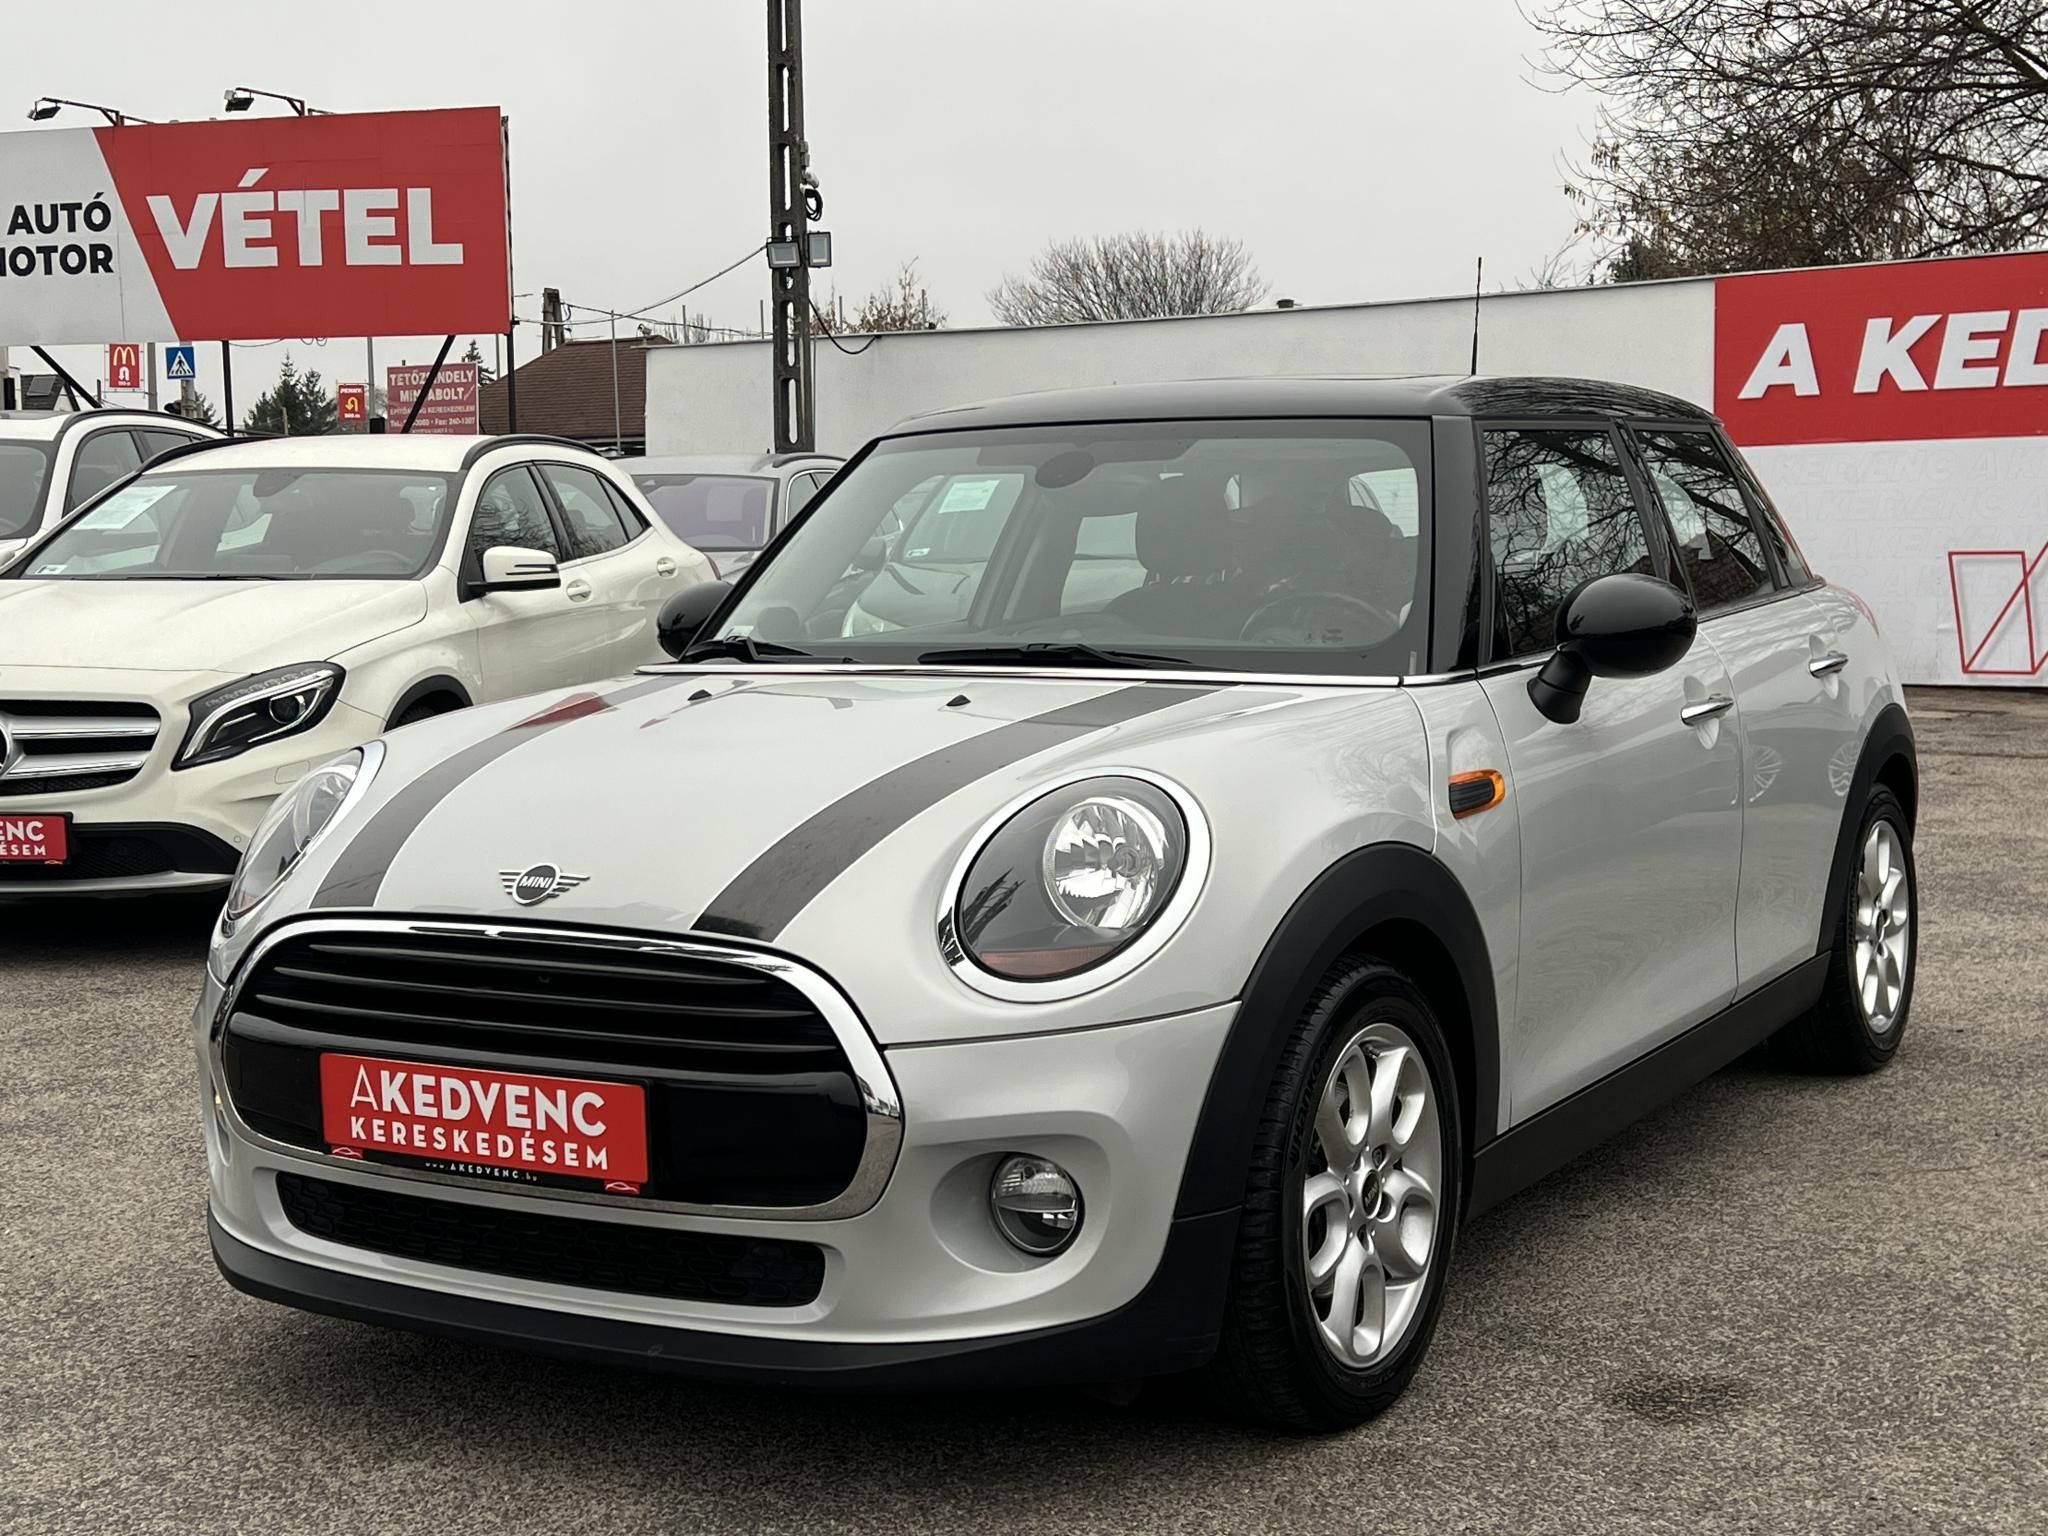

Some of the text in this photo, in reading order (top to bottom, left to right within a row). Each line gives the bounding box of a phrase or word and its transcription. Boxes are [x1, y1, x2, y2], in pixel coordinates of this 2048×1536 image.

[7, 191, 112, 236] AUTÓ
[146, 167, 465, 270] VÉTEL
[0, 243, 115, 277] OTOR
[389, 369, 474, 387] TETŐZNDELY
[1737, 322, 1821, 400] A
[399, 387, 465, 403] MINABOLT
[519, 875, 554, 889] MINI
[350, 1063, 607, 1138] AKEDVENC
[350, 1115, 609, 1171] KERESKEDÉSEM
